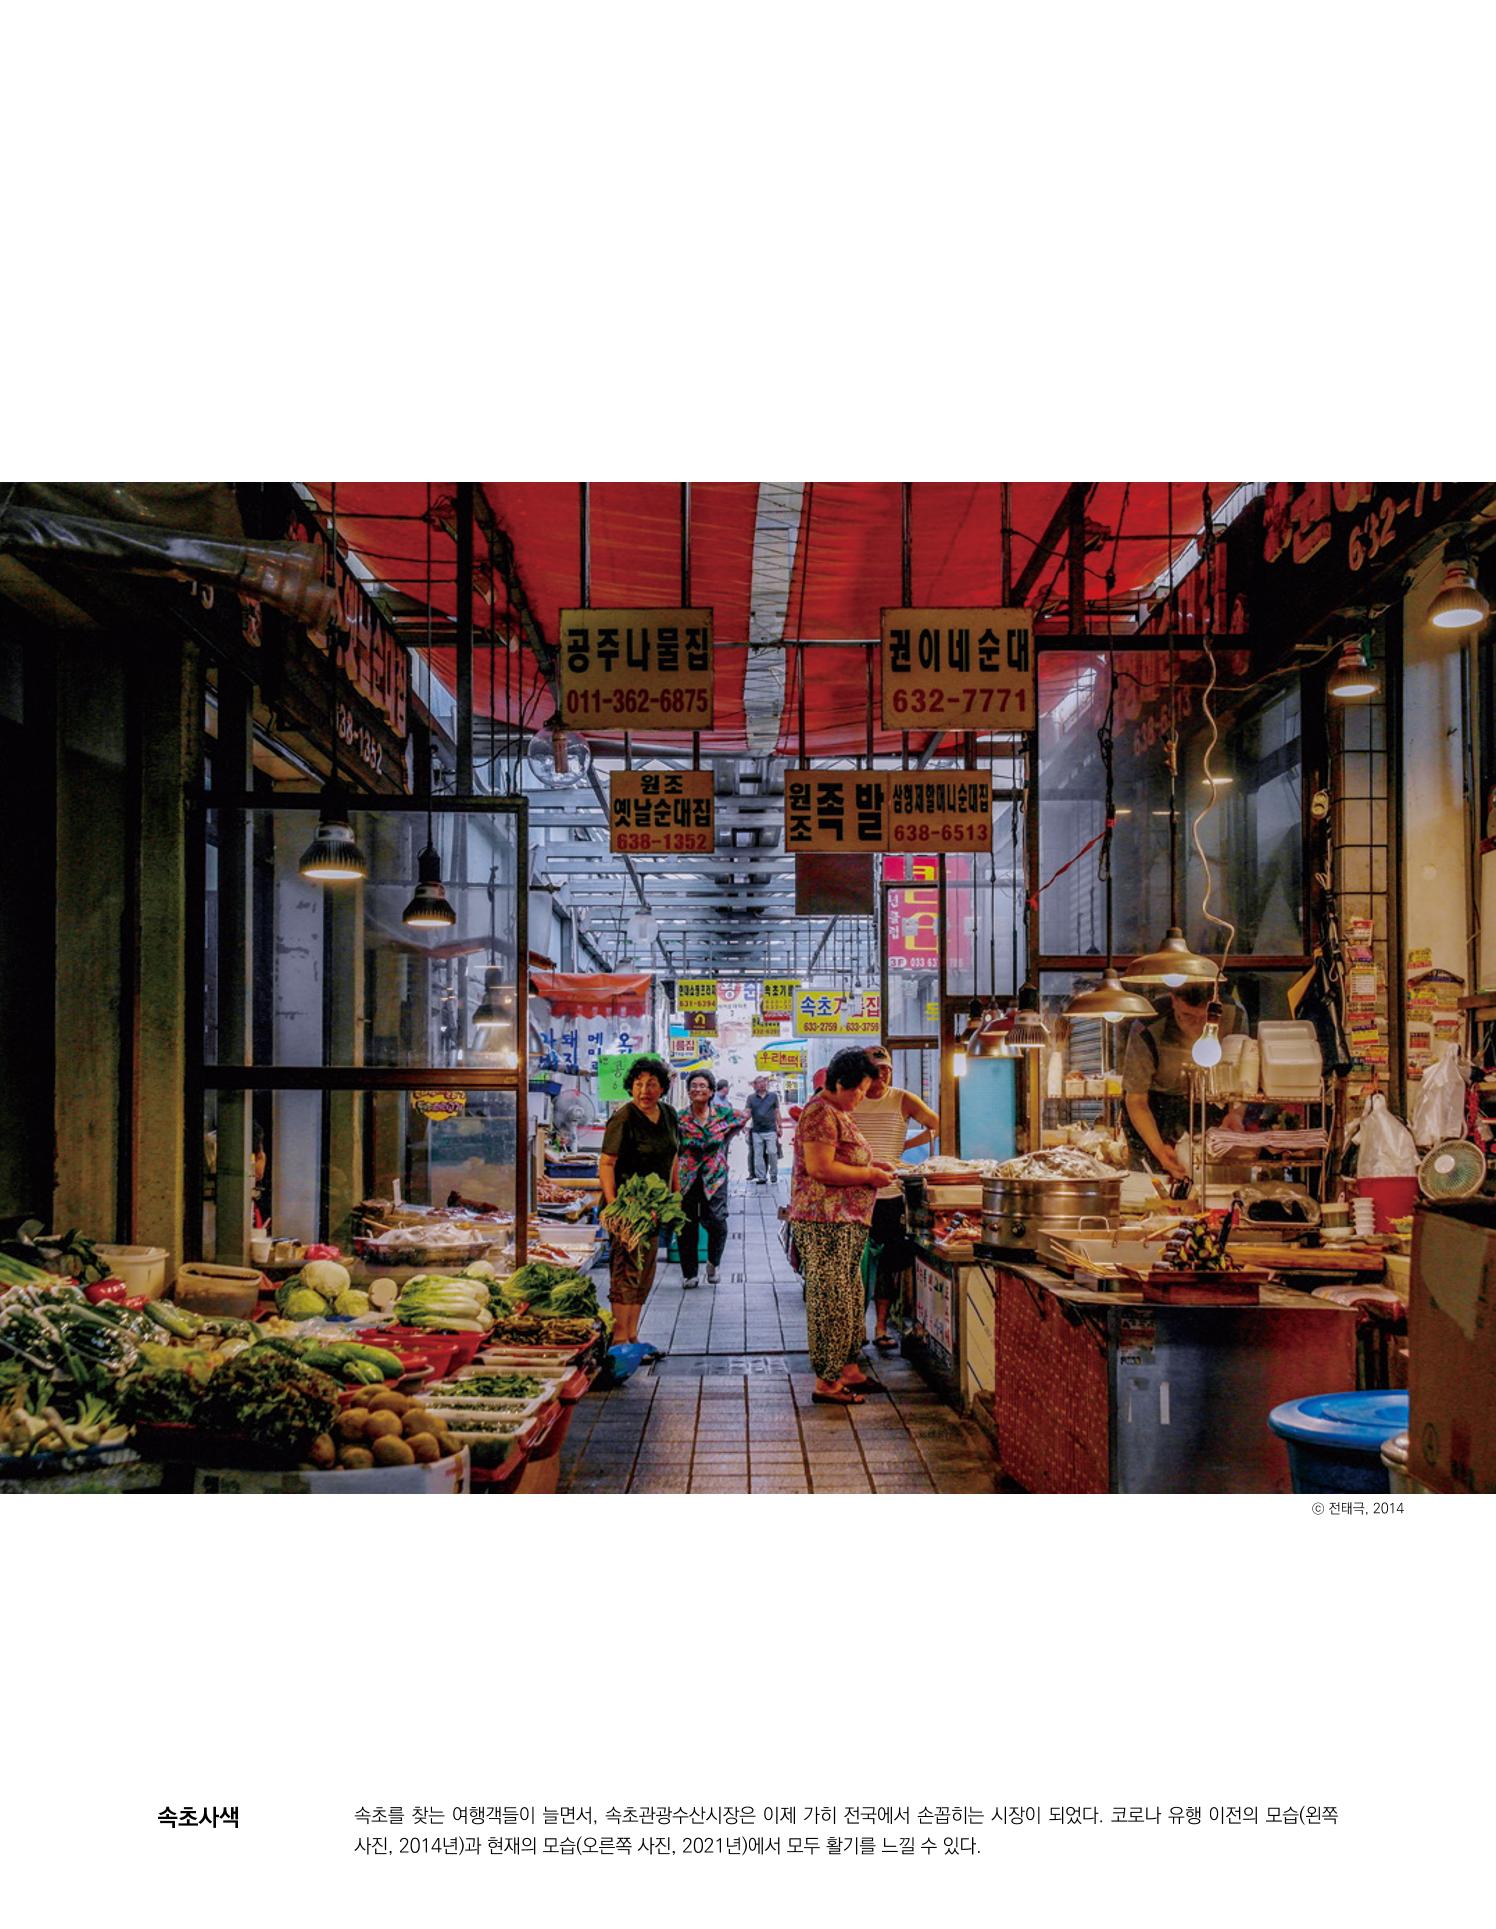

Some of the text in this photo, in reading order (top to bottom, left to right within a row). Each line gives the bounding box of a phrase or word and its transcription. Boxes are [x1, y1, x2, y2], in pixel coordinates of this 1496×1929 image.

[567, 628, 709, 673] 공주나물집
[889, 628, 1029, 672] 권이네순대
[567, 688, 708, 713] 011-362-6875
[892, 688, 1026, 712] 632-7771
[640, 774, 683, 795] 원조
[893, 783, 989, 814] 삼형제할머니순대집
[613, 798, 711, 828] 옛날순대집
[616, 833, 707, 850] 638-1352
[894, 823, 988, 842] 638-6513
